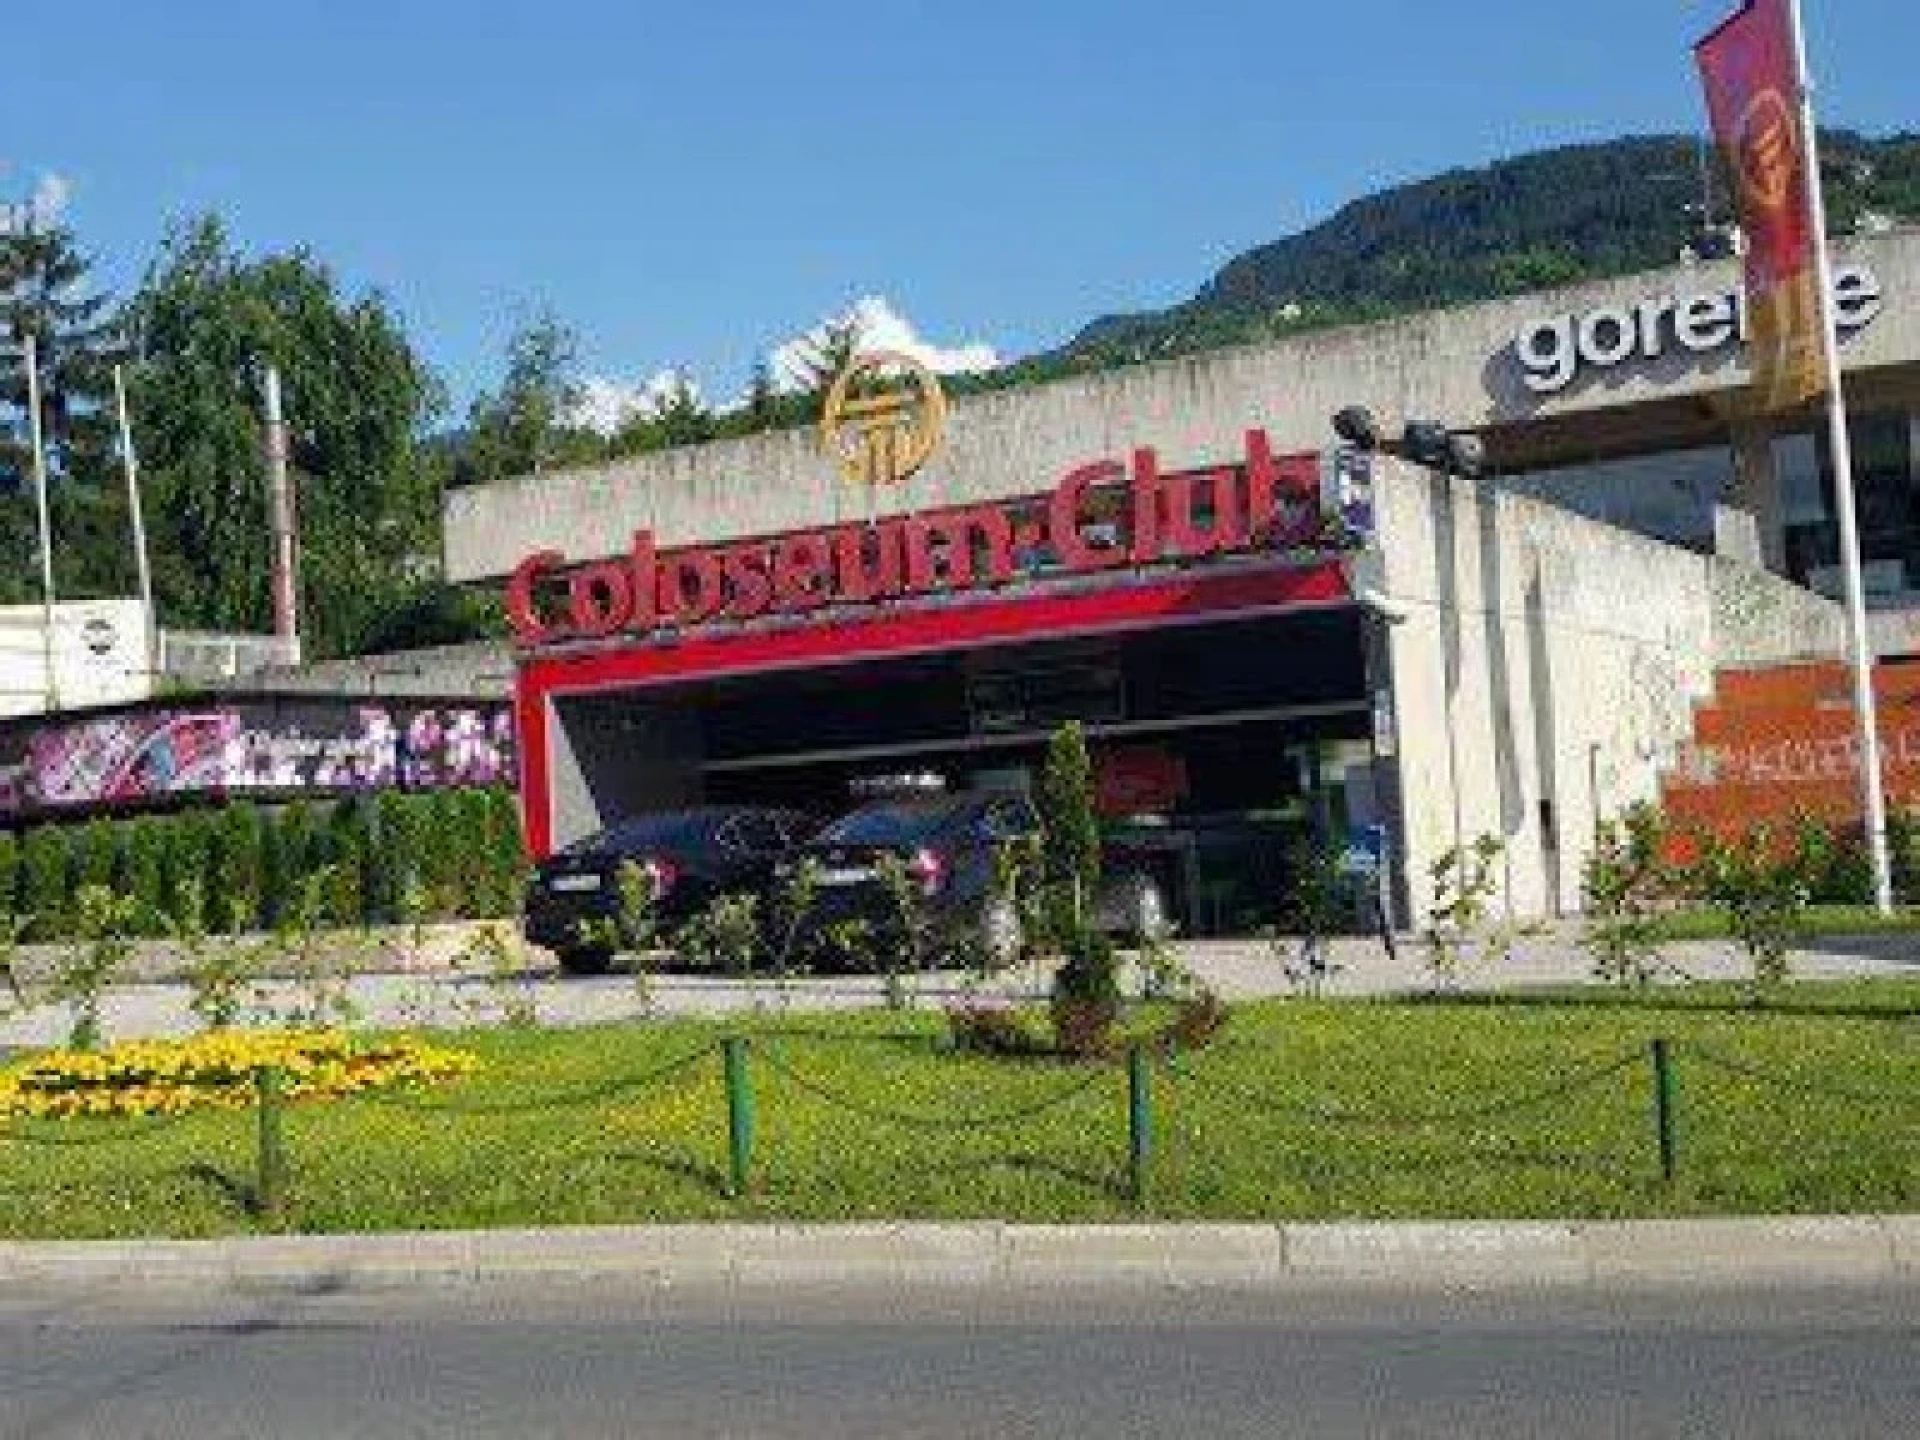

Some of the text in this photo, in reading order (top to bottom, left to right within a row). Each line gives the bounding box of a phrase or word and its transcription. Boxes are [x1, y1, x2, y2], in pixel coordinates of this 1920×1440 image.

[1518, 266, 1881, 392] goree
[505, 428, 1321, 645] Coloseum Club
